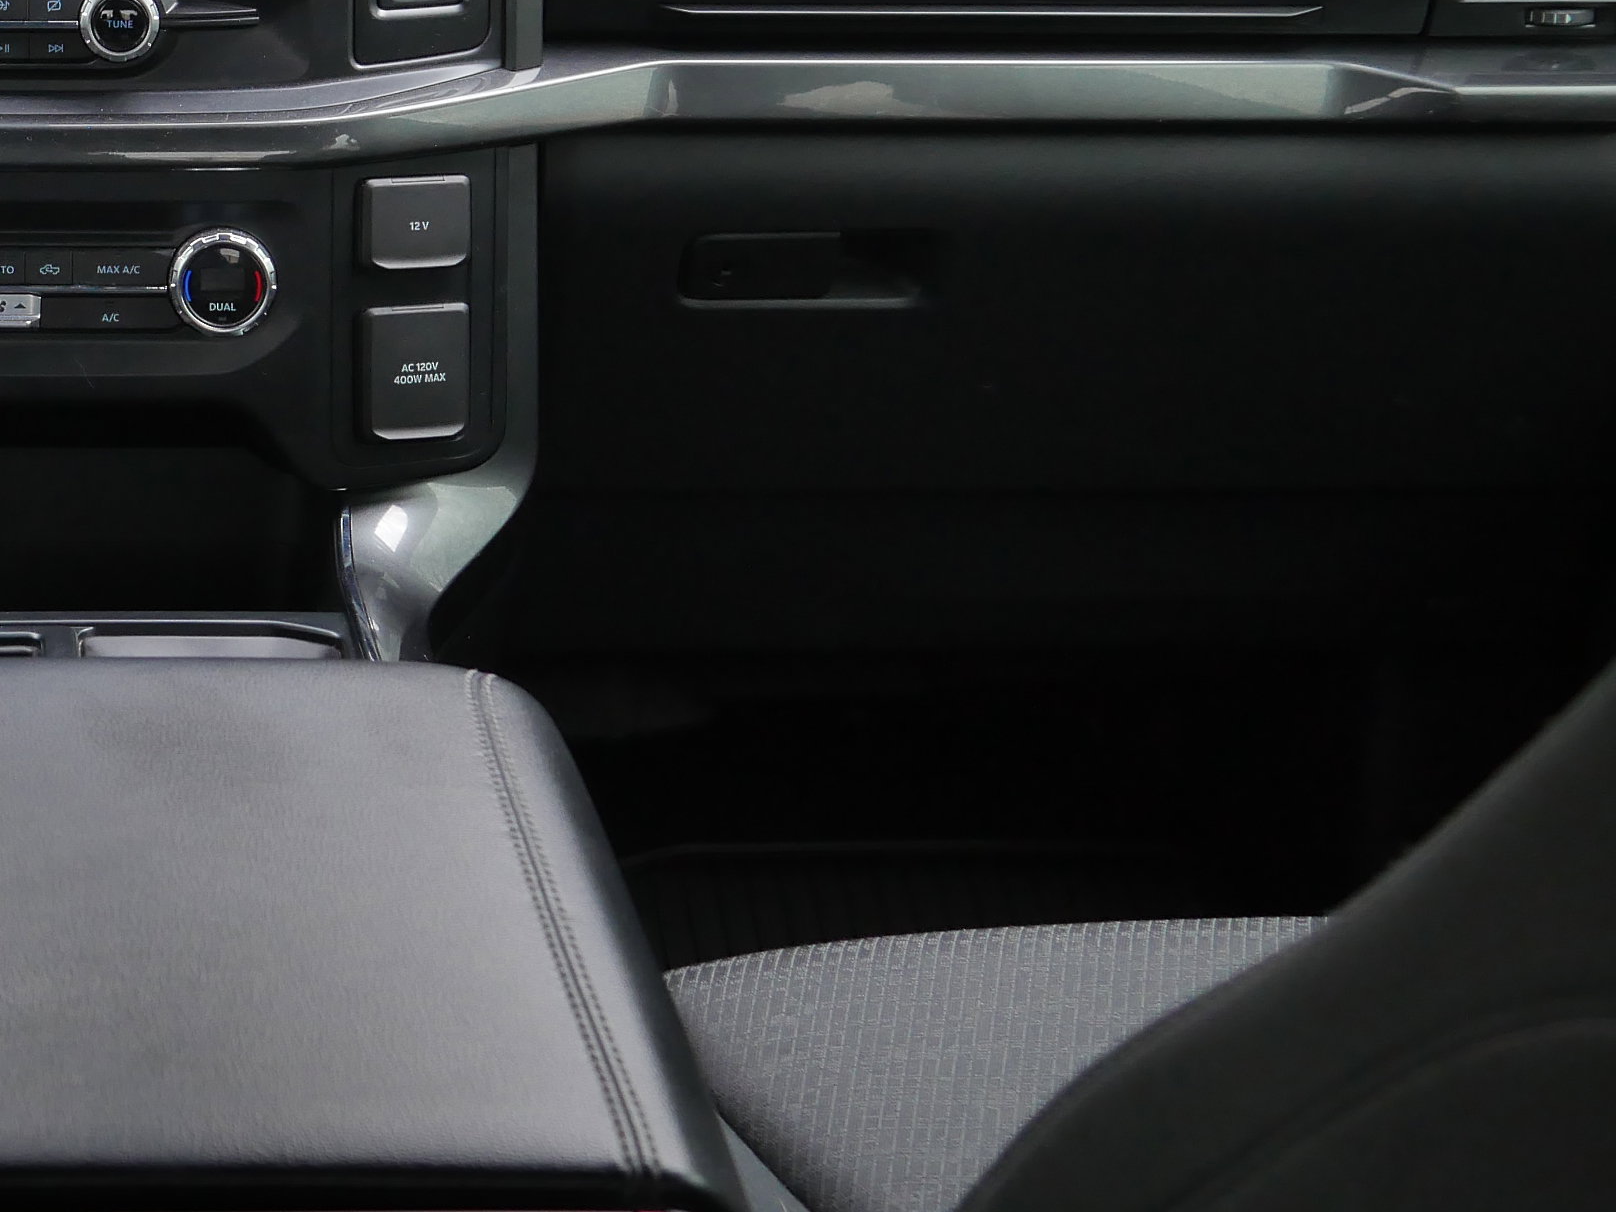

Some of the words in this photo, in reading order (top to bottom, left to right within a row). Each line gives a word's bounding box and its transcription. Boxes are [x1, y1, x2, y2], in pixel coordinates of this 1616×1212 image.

[106, 20, 134, 29] TUNE
[409, 222, 421, 231] 12
[422, 221, 429, 231] V
[96, 265, 120, 274] MAX
[122, 265, 141, 275] A/C
[209, 302, 236, 312] DUAL
[101, 313, 120, 323] A/C
[401, 363, 415, 373] AC
[415, 362, 439, 372] 120V
[393, 374, 422, 384] 400W
[424, 372, 446, 383] MAX
